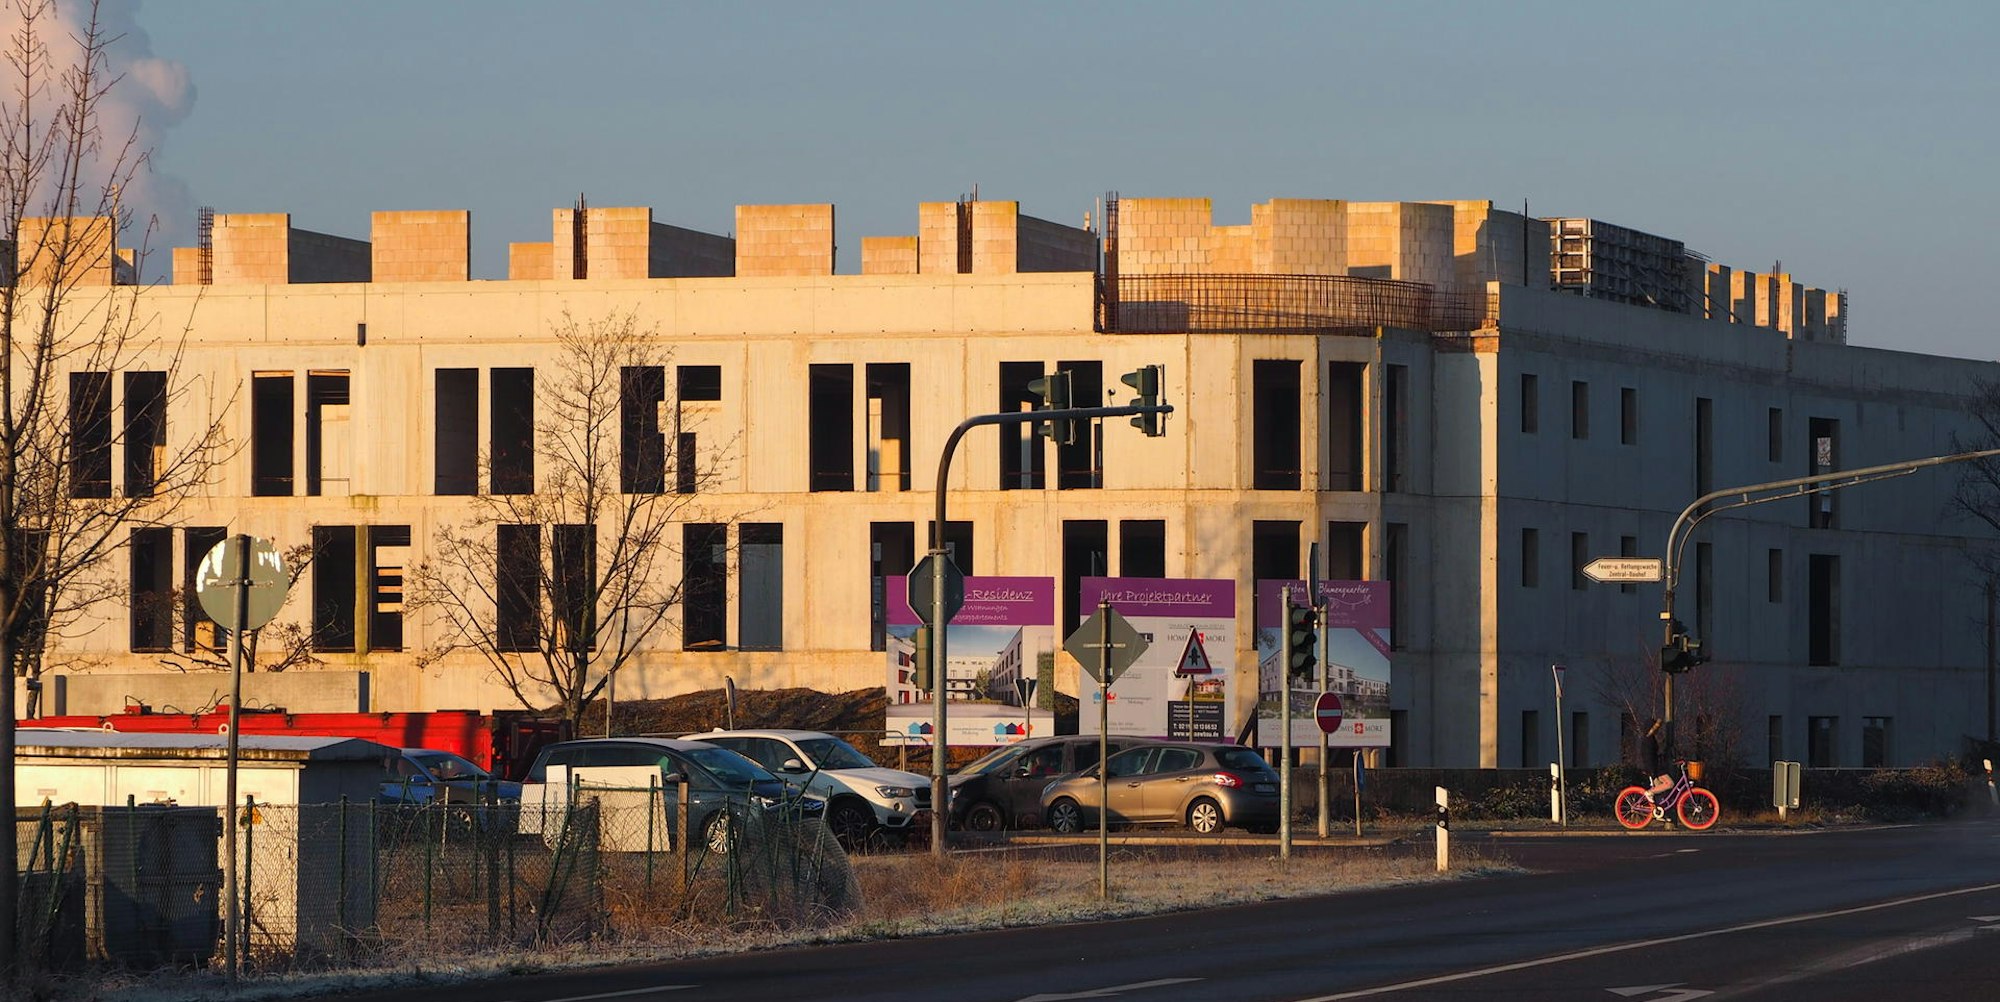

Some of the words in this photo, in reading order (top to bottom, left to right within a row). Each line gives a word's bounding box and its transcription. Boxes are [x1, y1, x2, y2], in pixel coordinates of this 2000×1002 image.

[1620, 563, 1657, 571] Rettungswache
[964, 588, 1034, 600] -Residenz
[1318, 583, 1370, 598] Blumenquartier
[1100, 589, 1124, 602] Ihre
[1126, 588, 1213, 607] Projektpartner
